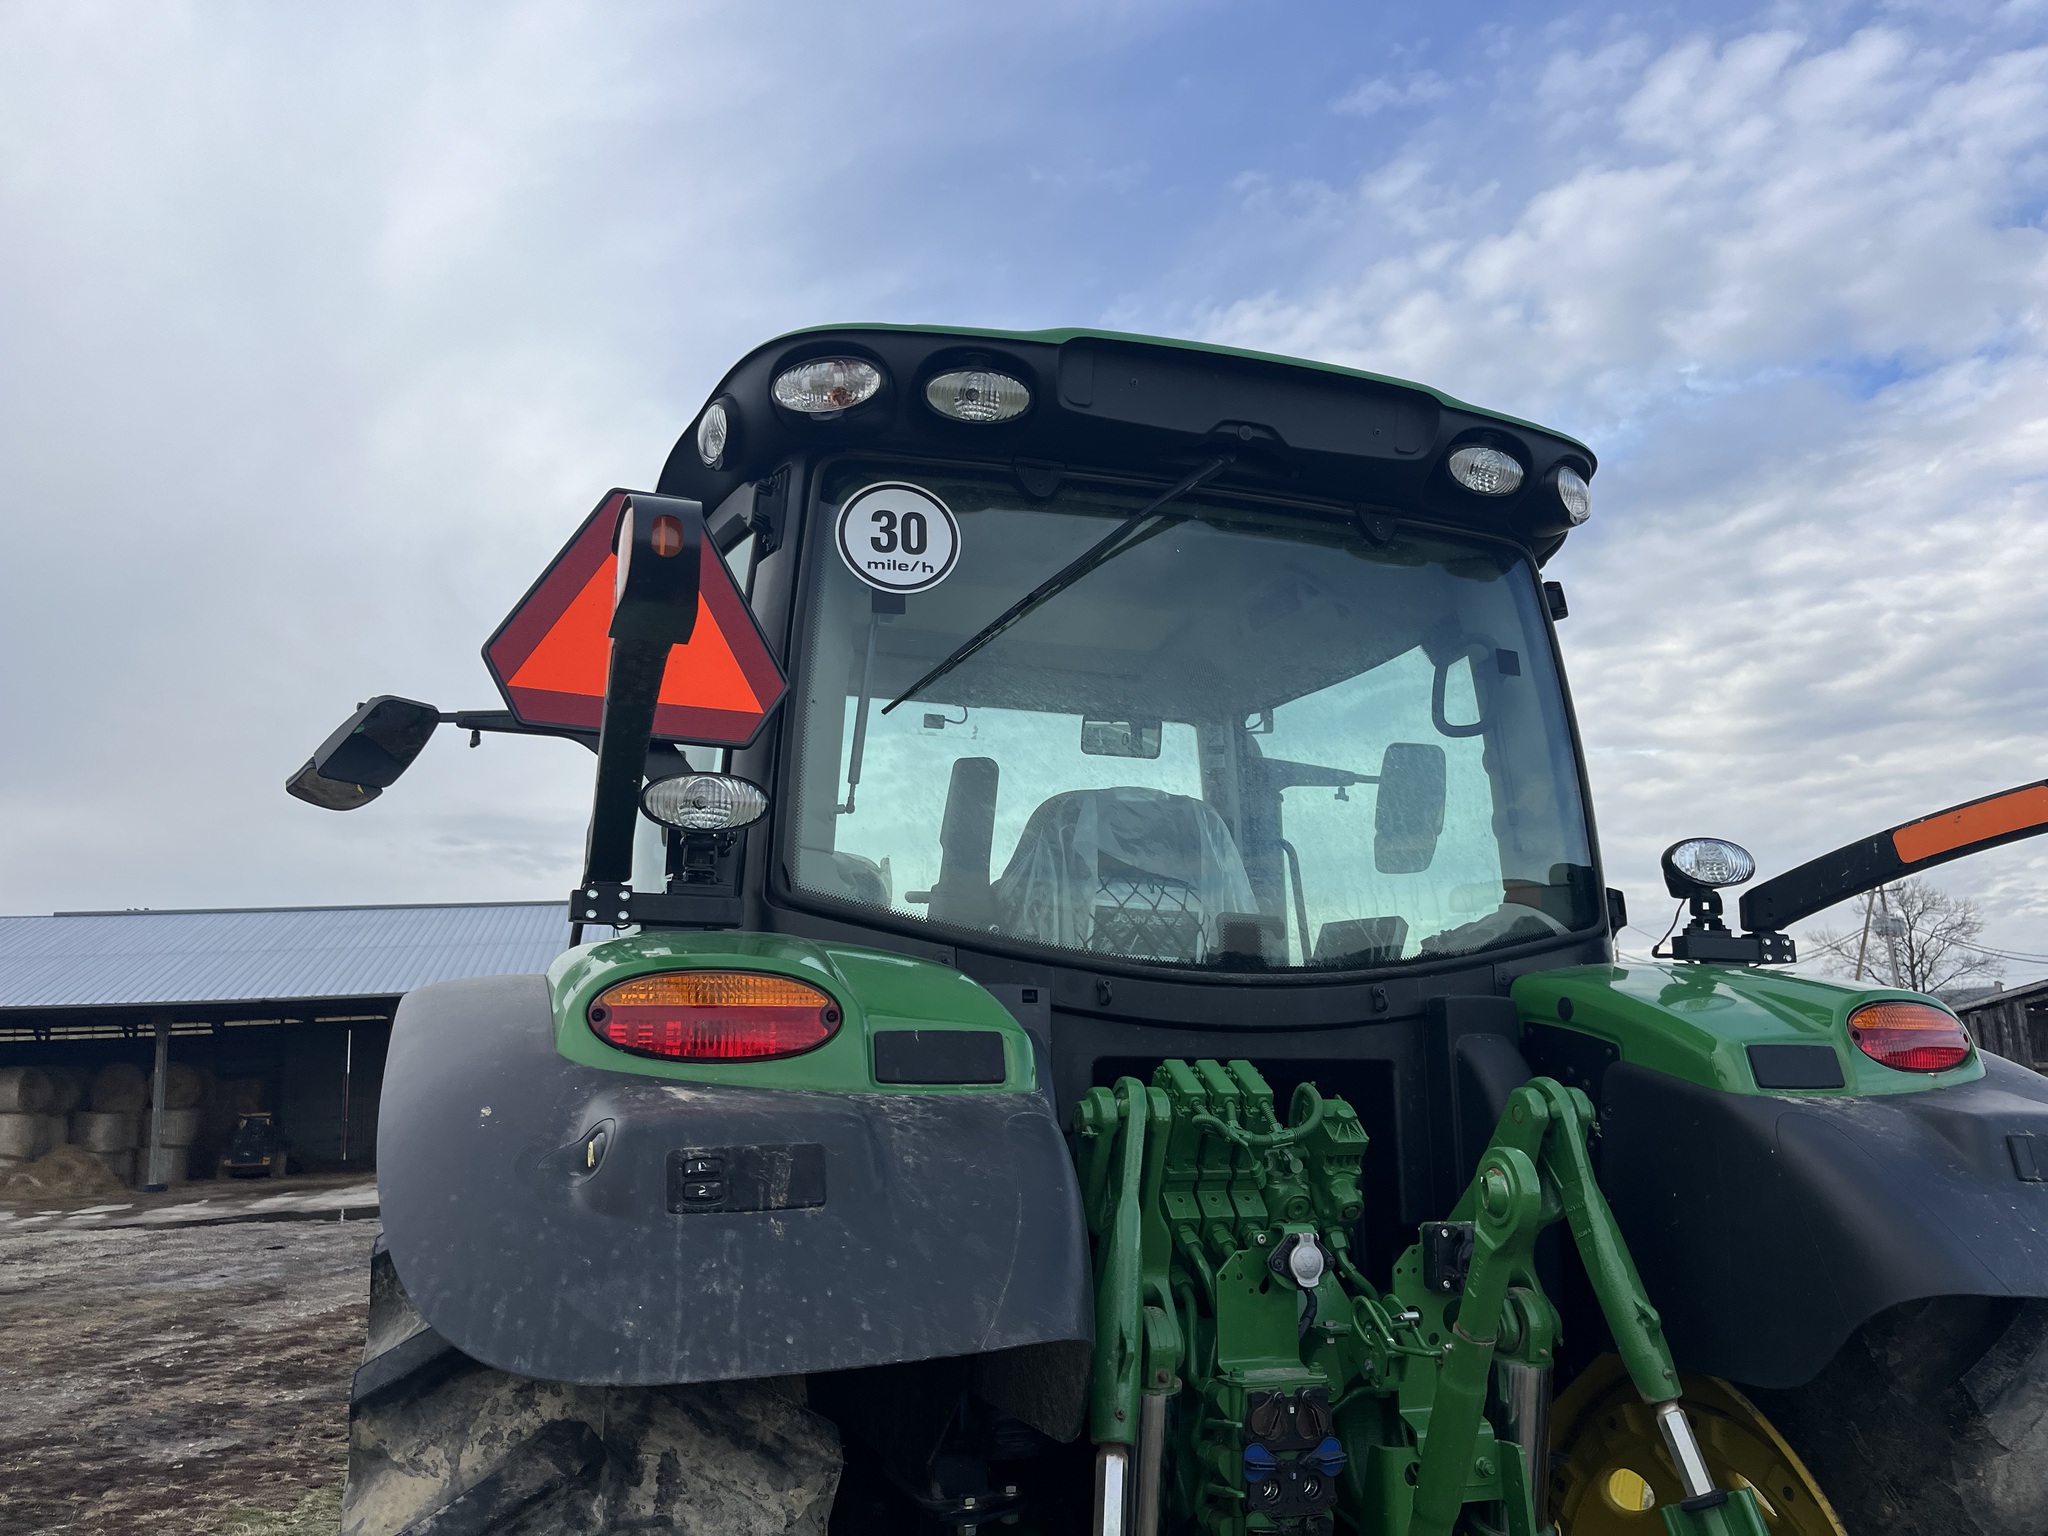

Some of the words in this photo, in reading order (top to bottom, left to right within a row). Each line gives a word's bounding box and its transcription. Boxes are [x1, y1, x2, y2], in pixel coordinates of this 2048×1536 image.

[870, 510, 927, 555] 30
[867, 559, 934, 573] mile/h
[1113, 913, 1146, 924] JOHN
